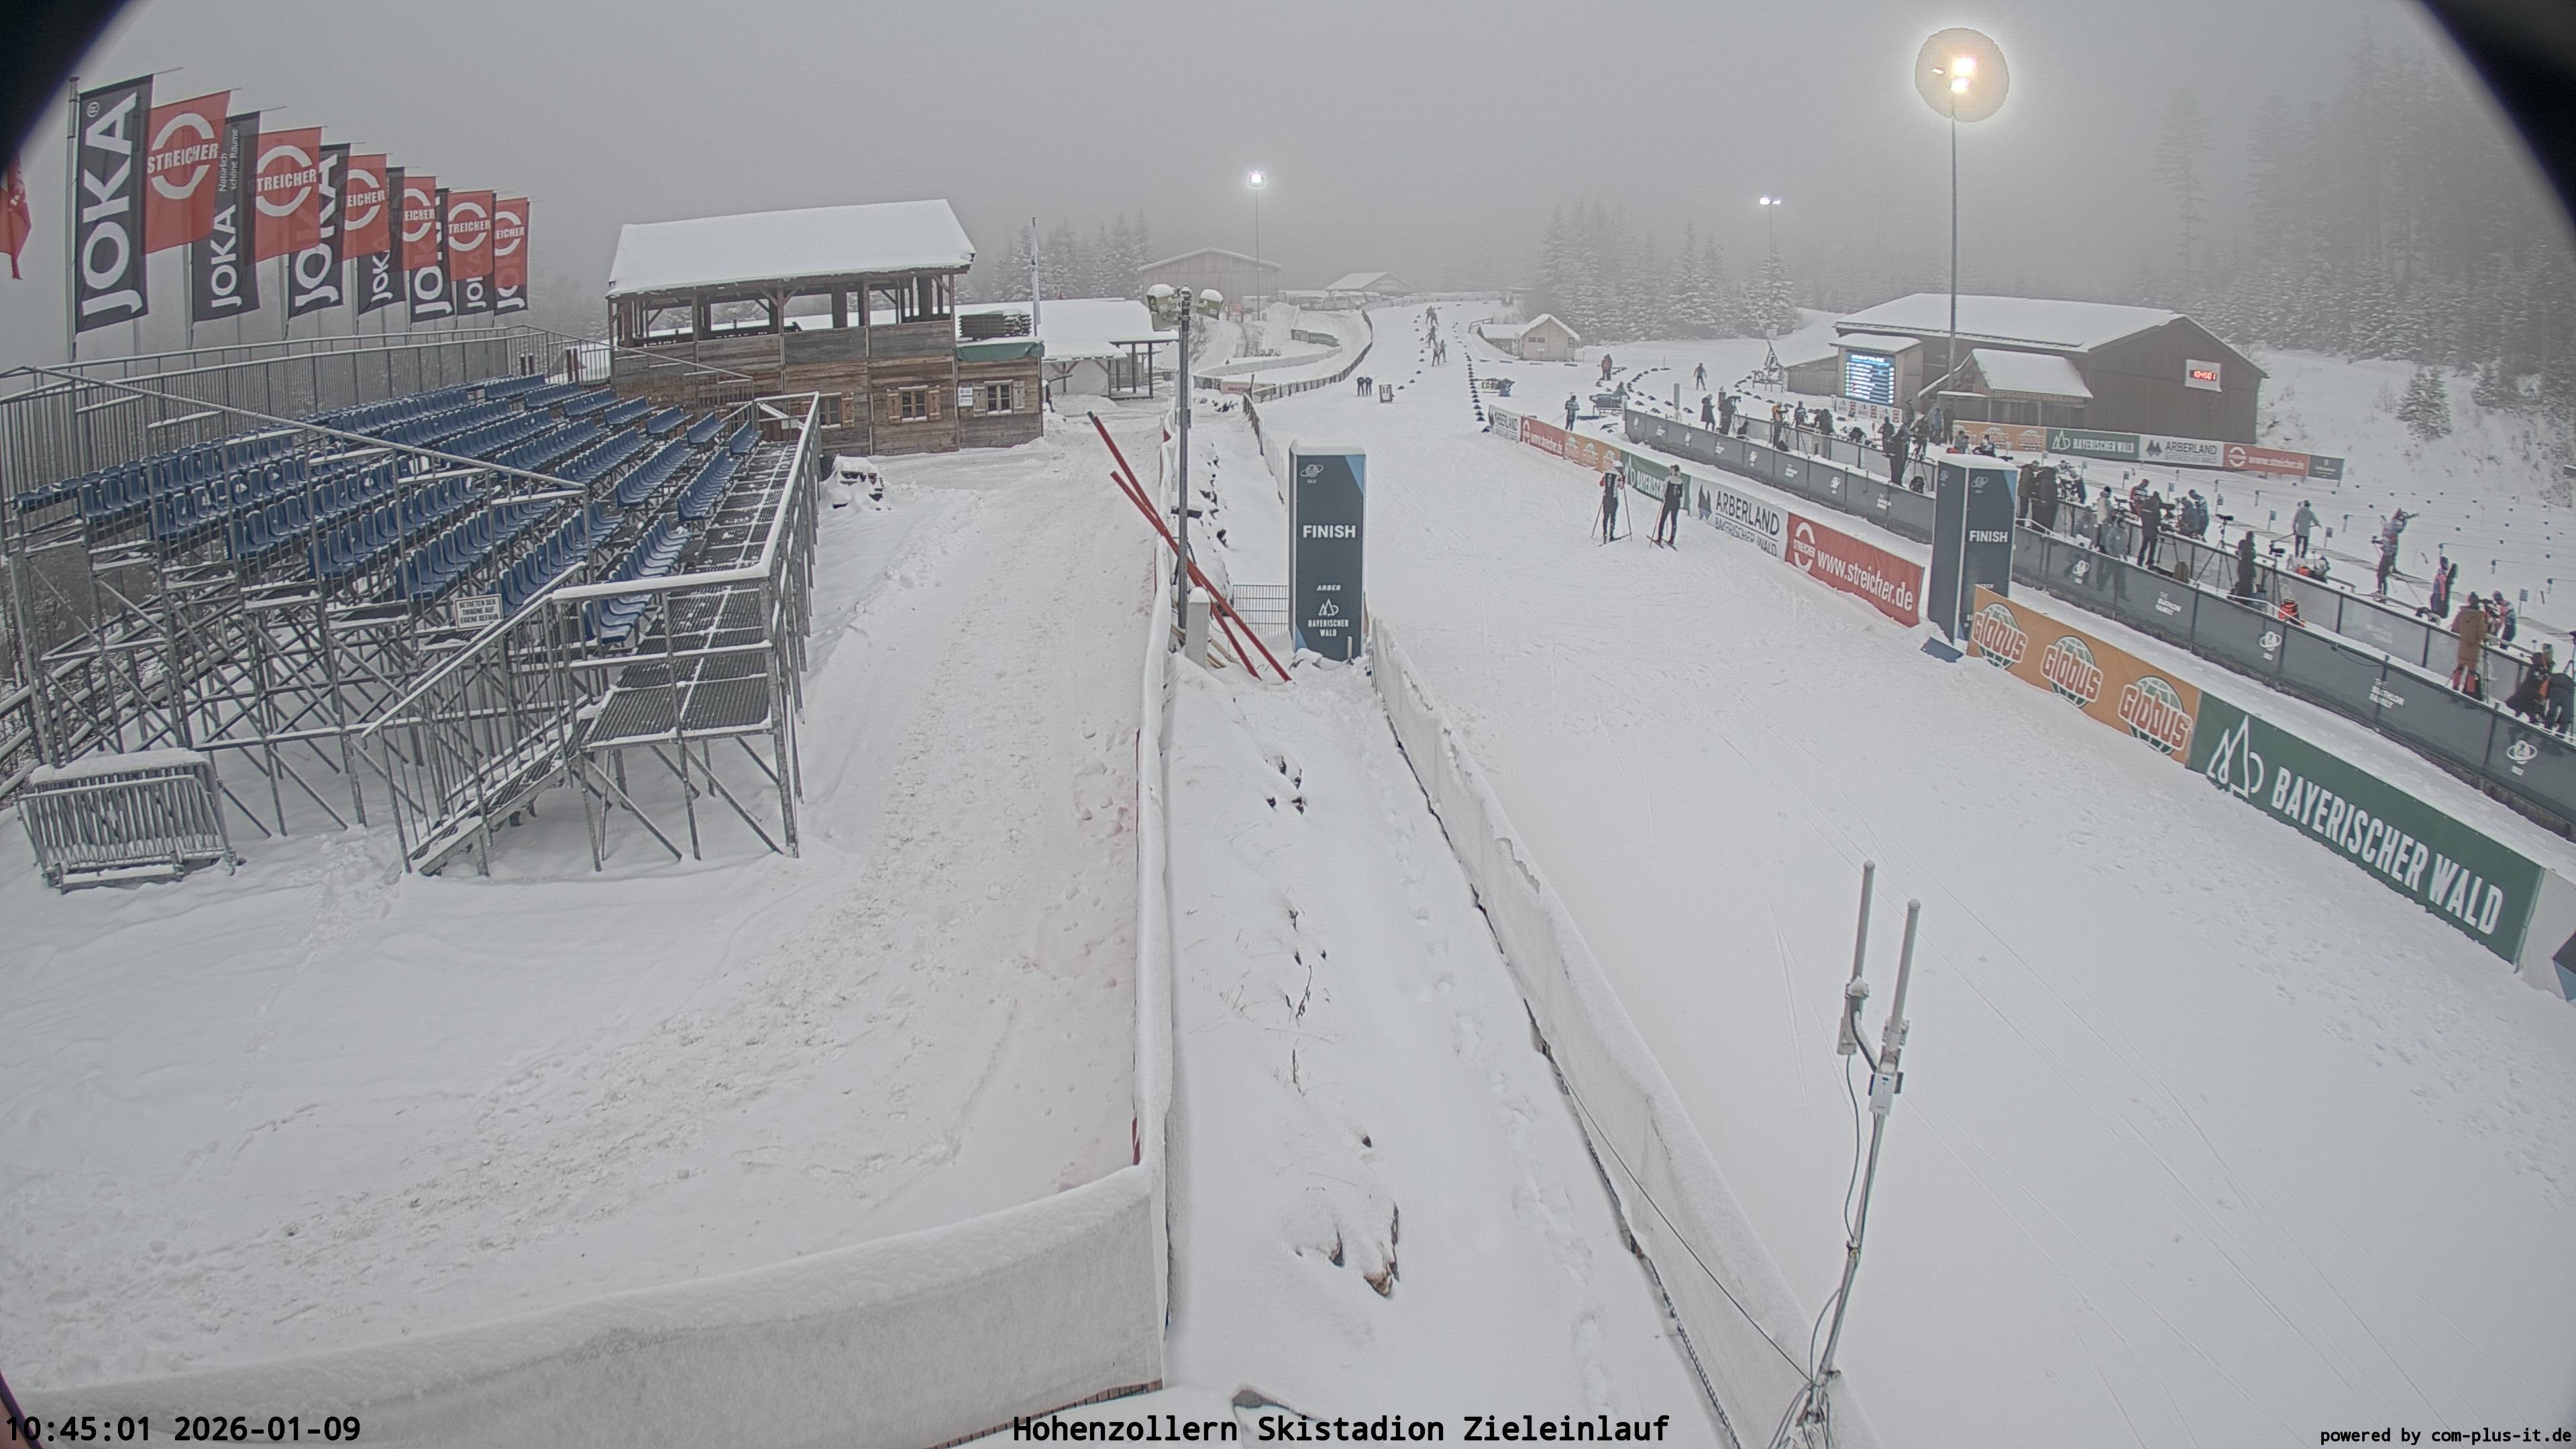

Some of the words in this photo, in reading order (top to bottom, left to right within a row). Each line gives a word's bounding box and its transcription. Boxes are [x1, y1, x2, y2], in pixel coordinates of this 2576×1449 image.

[147, 143, 219, 173] STREICHER
[250, 168, 317, 194] TREICHER
[448, 219, 491, 234] TREICHER
[211, 204, 242, 307] JOKA
[2165, 441, 2218, 455] ARBERLAND
[1715, 490, 1780, 535] ARBERLAND
[1303, 525, 1356, 538] FINISH
[1969, 530, 2008, 543] FINISH
[1817, 550, 1913, 611] www.streicher.de
[1308, 619, 1349, 627] BAYERISCHER
[1320, 629, 1337, 637] WALD
[2271, 766, 2429, 892] BAYERISCHER
[2428, 853, 2504, 935] WALD
